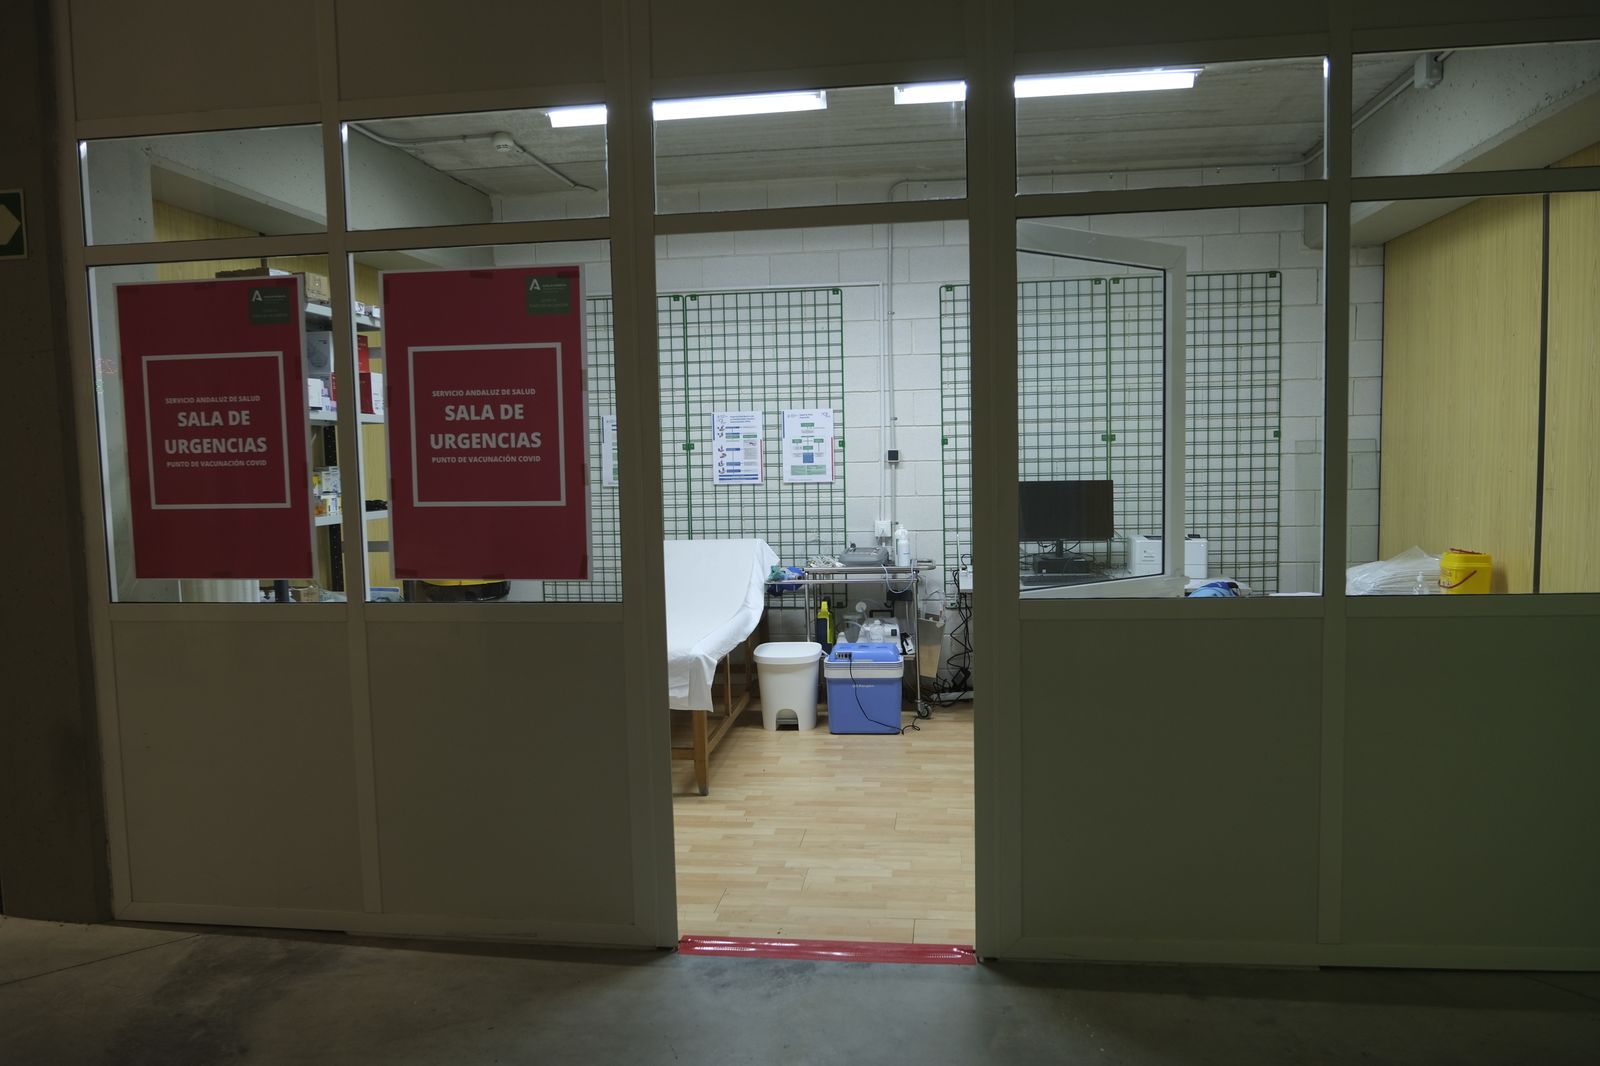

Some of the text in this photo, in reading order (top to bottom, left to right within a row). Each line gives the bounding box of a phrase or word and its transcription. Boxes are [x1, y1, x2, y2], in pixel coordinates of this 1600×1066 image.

[165, 397, 195, 405] SERVICIO
[177, 410, 251, 427] SALA DE
[445, 404, 525, 421] SALA DE
[164, 437, 268, 454] URGENCIAS
[430, 432, 542, 450] URGENCIAS
[200, 459, 245, 467] VACUNACIÓN
[431, 456, 457, 464] PUNTO
[468, 454, 517, 463] VACUNACIÓN
[518, 455, 541, 463] COVID
